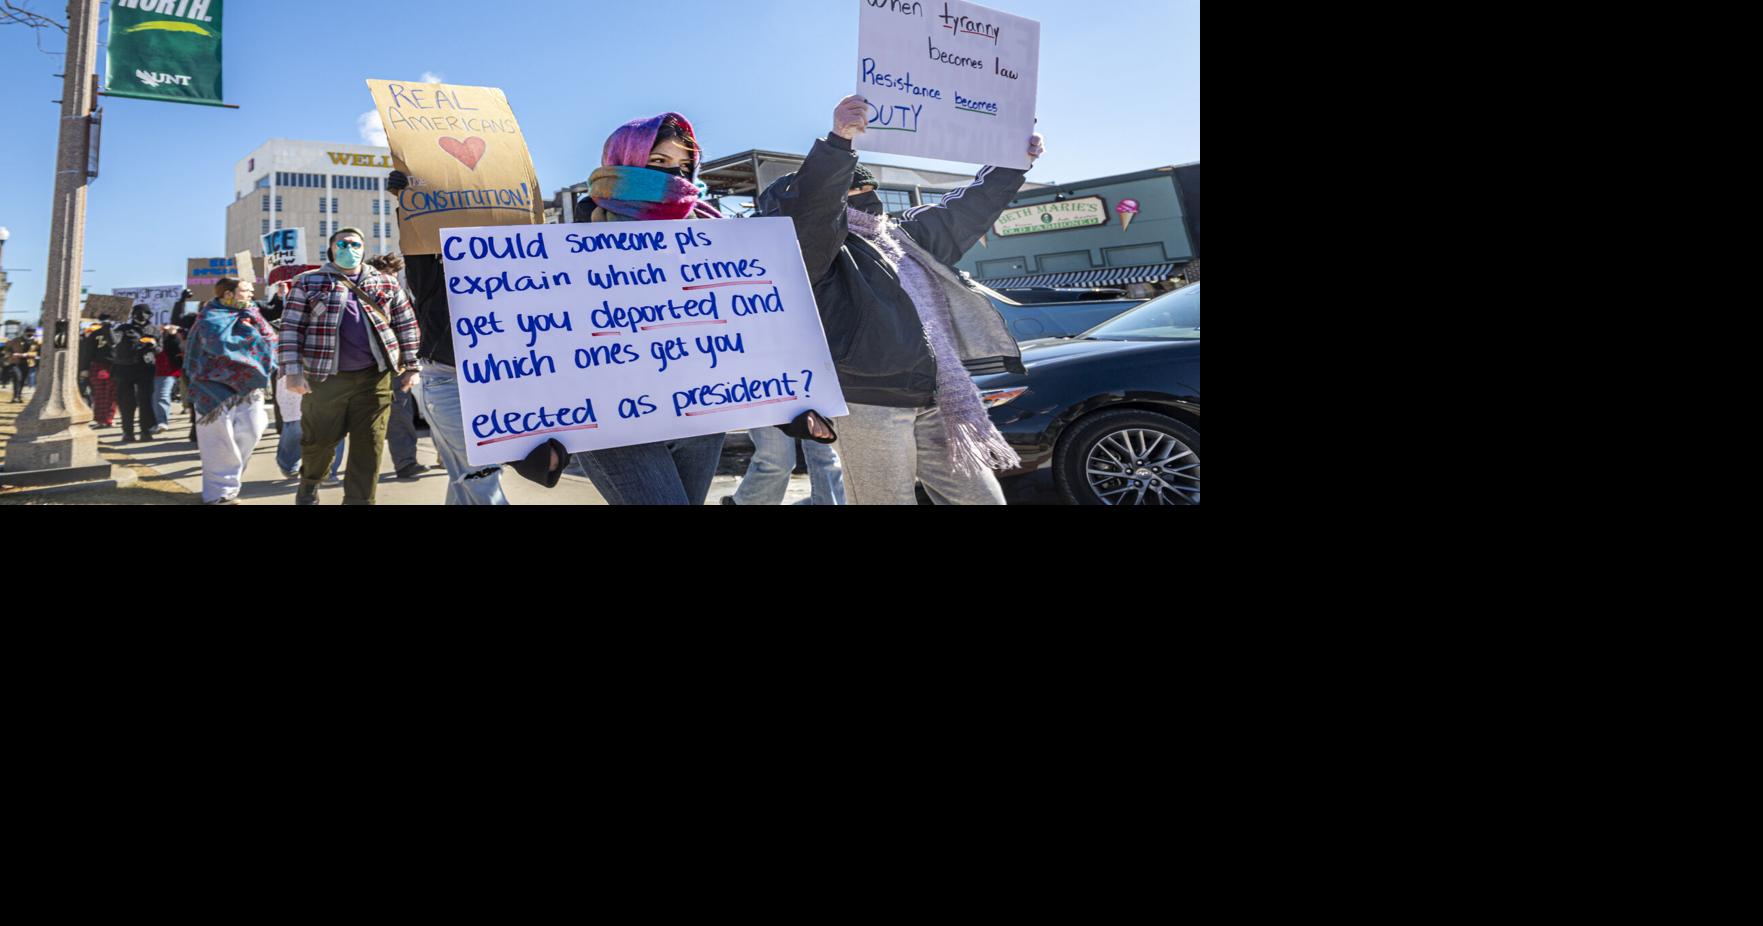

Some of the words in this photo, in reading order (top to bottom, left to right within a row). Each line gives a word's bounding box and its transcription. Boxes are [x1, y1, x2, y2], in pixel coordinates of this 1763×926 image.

[939, 2, 1000, 45] tyranny
[928, 36, 983, 69] becomes
[995, 58, 1018, 80] law
[150, 71, 192, 86] UNT
[862, 58, 941, 99] Resistance
[955, 91, 997, 112] becomes
[389, 83, 479, 110] REAL
[388, 106, 515, 134] AMERICANS
[866, 101, 923, 129] DUTY
[399, 183, 530, 211] CONSTITUTION!
[999, 209, 1032, 224] BETH
[1037, 203, 1098, 214] MARIE'S
[263, 230, 298, 254] ICE
[566, 231, 667, 254] someone
[675, 227, 711, 254] pls
[449, 271, 570, 300] explain
[588, 263, 666, 290] which
[682, 258, 766, 283] crimes
[456, 315, 504, 348] get
[517, 311, 572, 347] you
[591, 291, 719, 333] deported
[732, 286, 784, 317] and
[462, 350, 555, 384] which
[574, 342, 639, 369] ones
[651, 337, 688, 371] get
[696, 332, 745, 369] you
[471, 399, 597, 438] elected
[618, 394, 657, 419] as
[673, 369, 813, 417] president?
